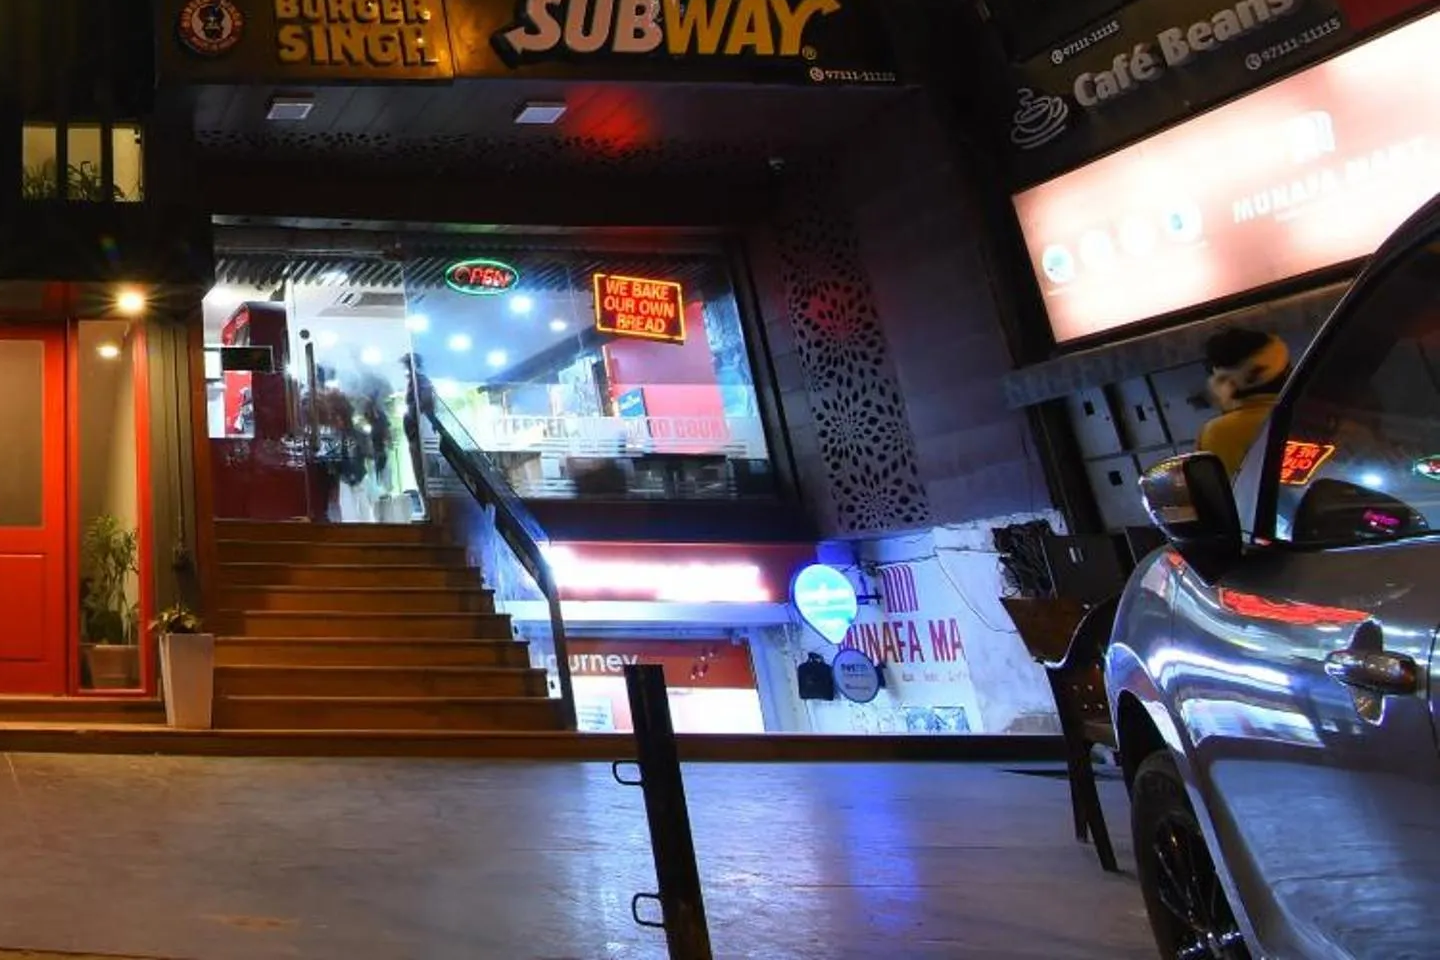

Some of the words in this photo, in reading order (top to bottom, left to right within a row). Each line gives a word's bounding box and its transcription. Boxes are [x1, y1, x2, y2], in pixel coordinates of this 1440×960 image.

[278, 25, 438, 66] SINGH
[1073, 42, 1161, 107] Café
[454, 266, 512, 288] OPEN
[605, 278, 630, 295] WE
[632, 280, 669, 300] BAKE
[604, 296, 634, 313] OUR
[638, 299, 675, 318] OWN
[616, 315, 666, 333] BREAD
